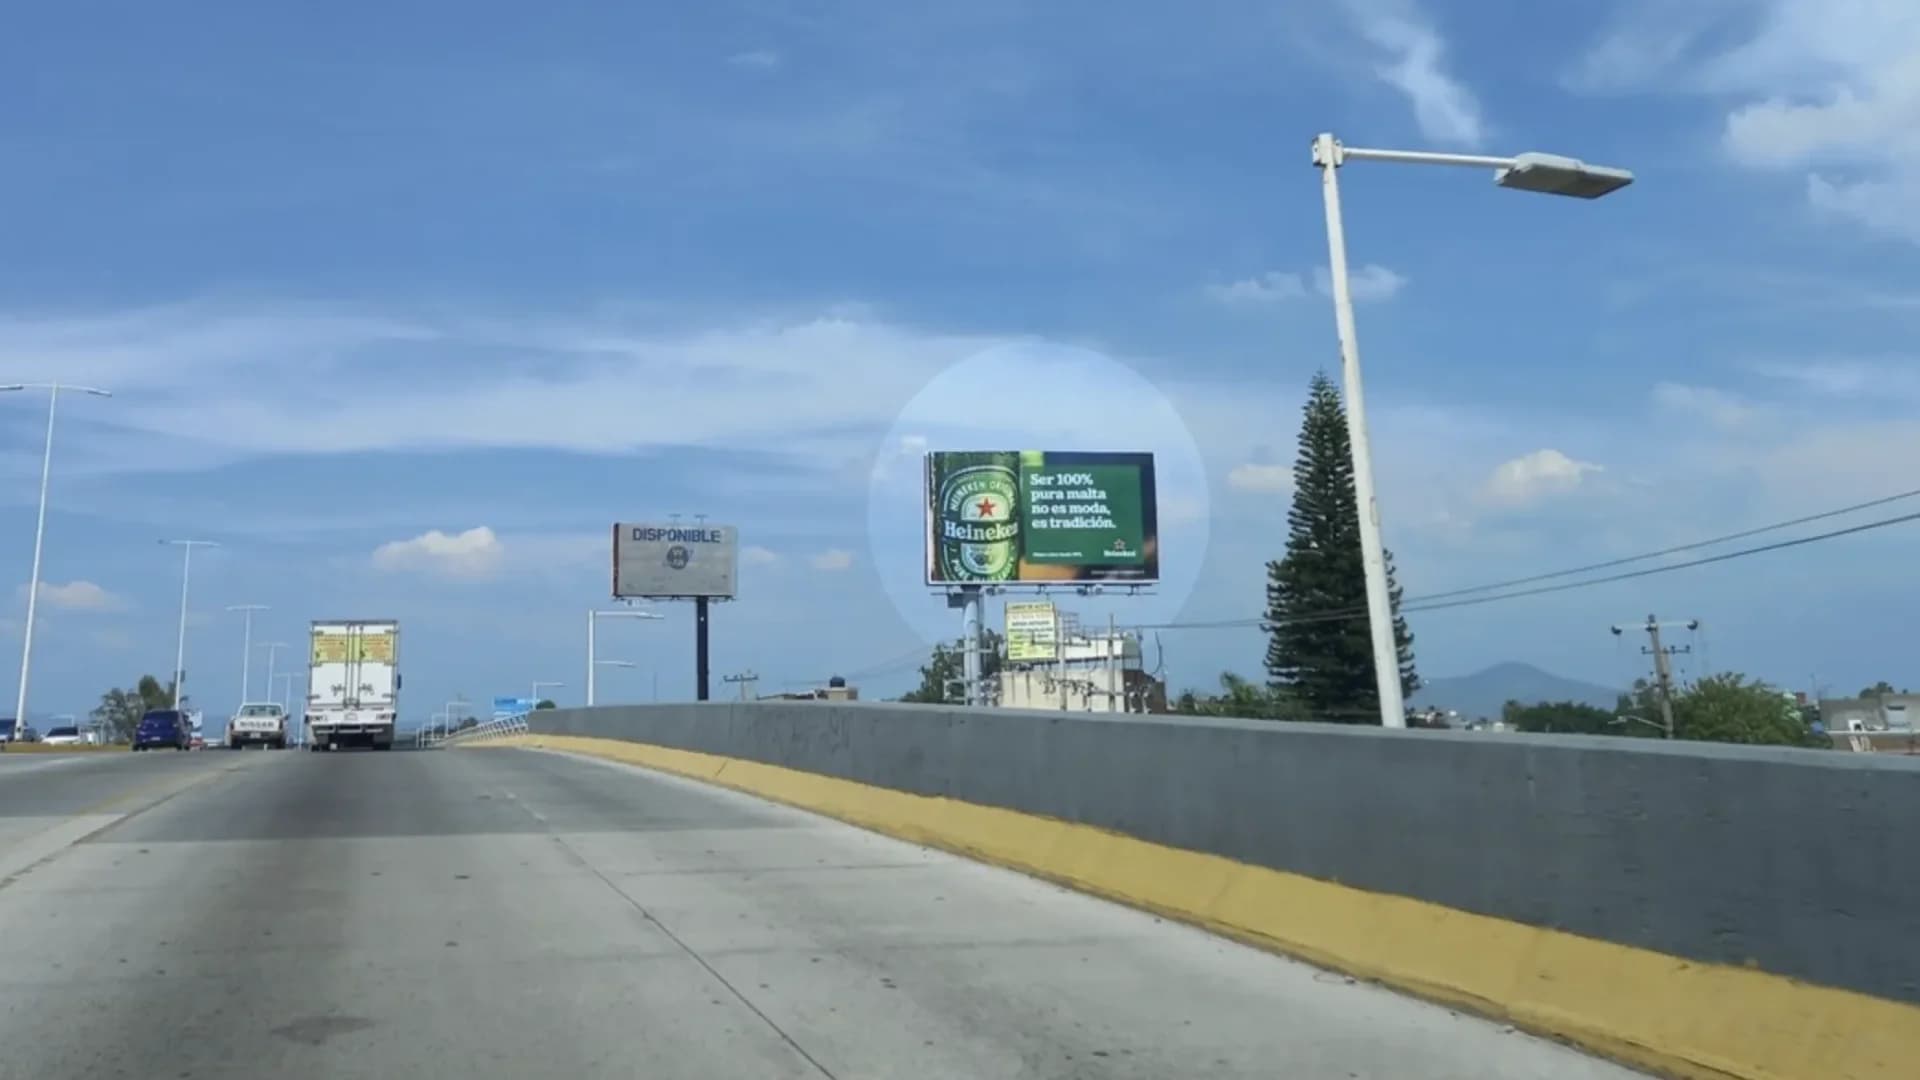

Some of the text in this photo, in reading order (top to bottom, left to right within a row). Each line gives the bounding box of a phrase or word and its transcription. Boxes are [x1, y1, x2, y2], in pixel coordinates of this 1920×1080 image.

[1030, 473, 1094, 486] Ser 100%
[1031, 488, 1107, 503] pura malta
[1031, 502, 1112, 516] no es moda,
[1032, 516, 1117, 529] es tradición.
[632, 528, 721, 543] DISPONIBLE
